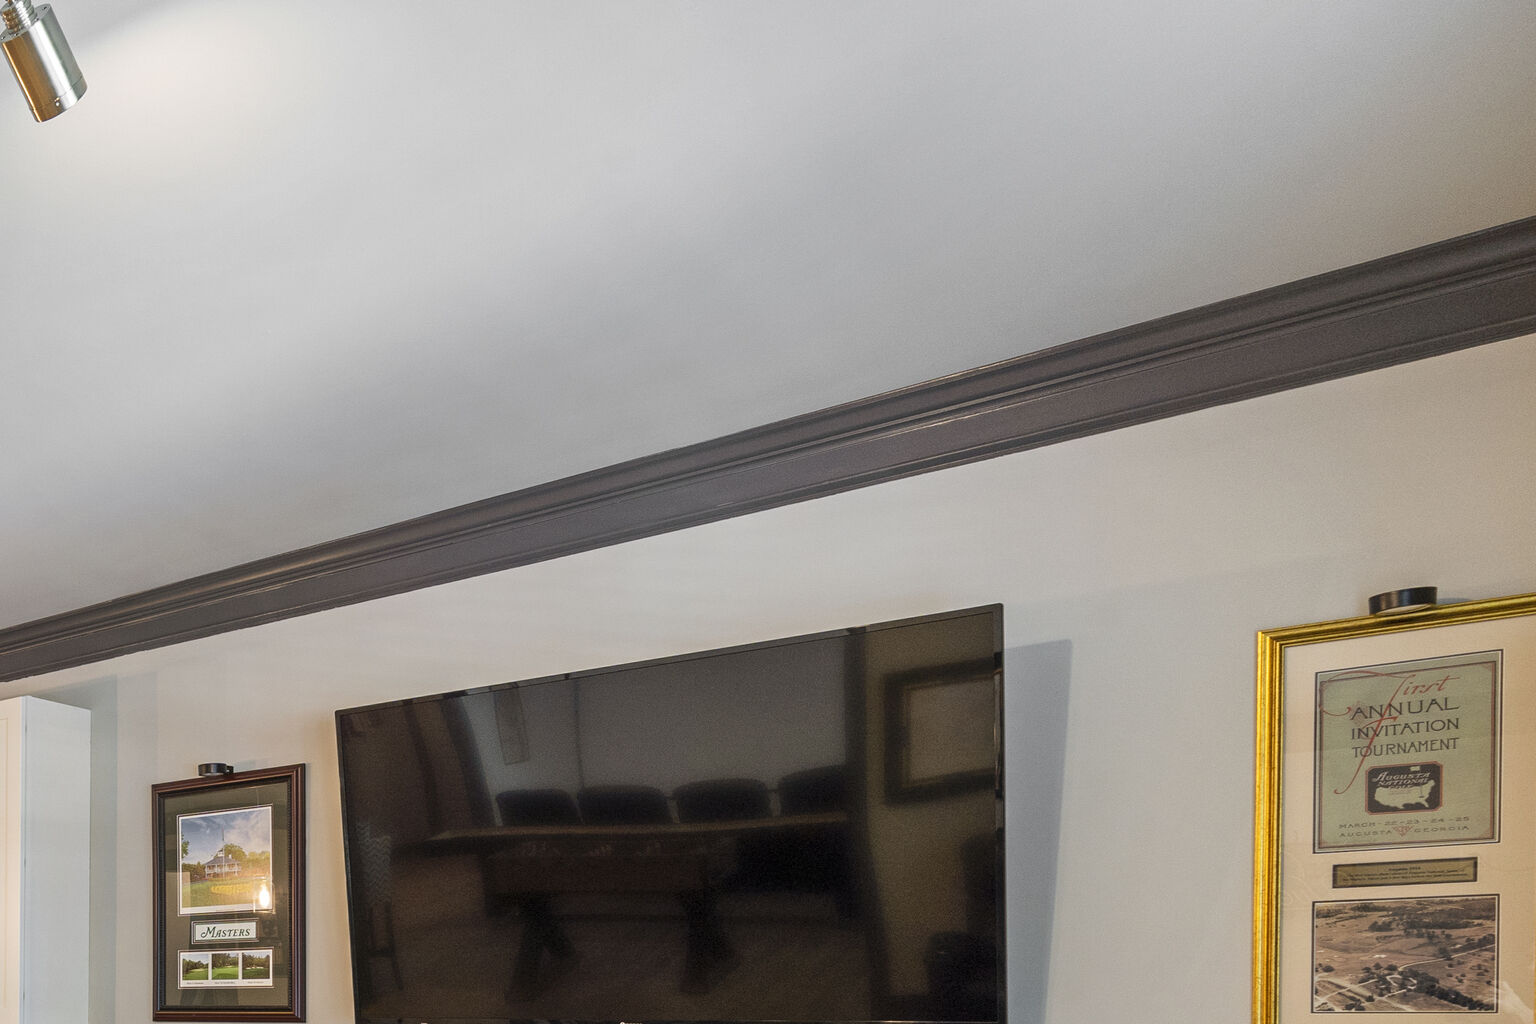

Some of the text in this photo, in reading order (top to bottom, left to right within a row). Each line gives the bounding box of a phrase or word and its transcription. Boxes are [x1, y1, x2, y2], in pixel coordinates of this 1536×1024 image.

[1350, 697, 1461, 721] ANNUAL
[1351, 718, 1461, 740] INVITATION
[1351, 738, 1461, 758] TOURNAMENT
[1373, 771, 1431, 781] AUGUSTA
